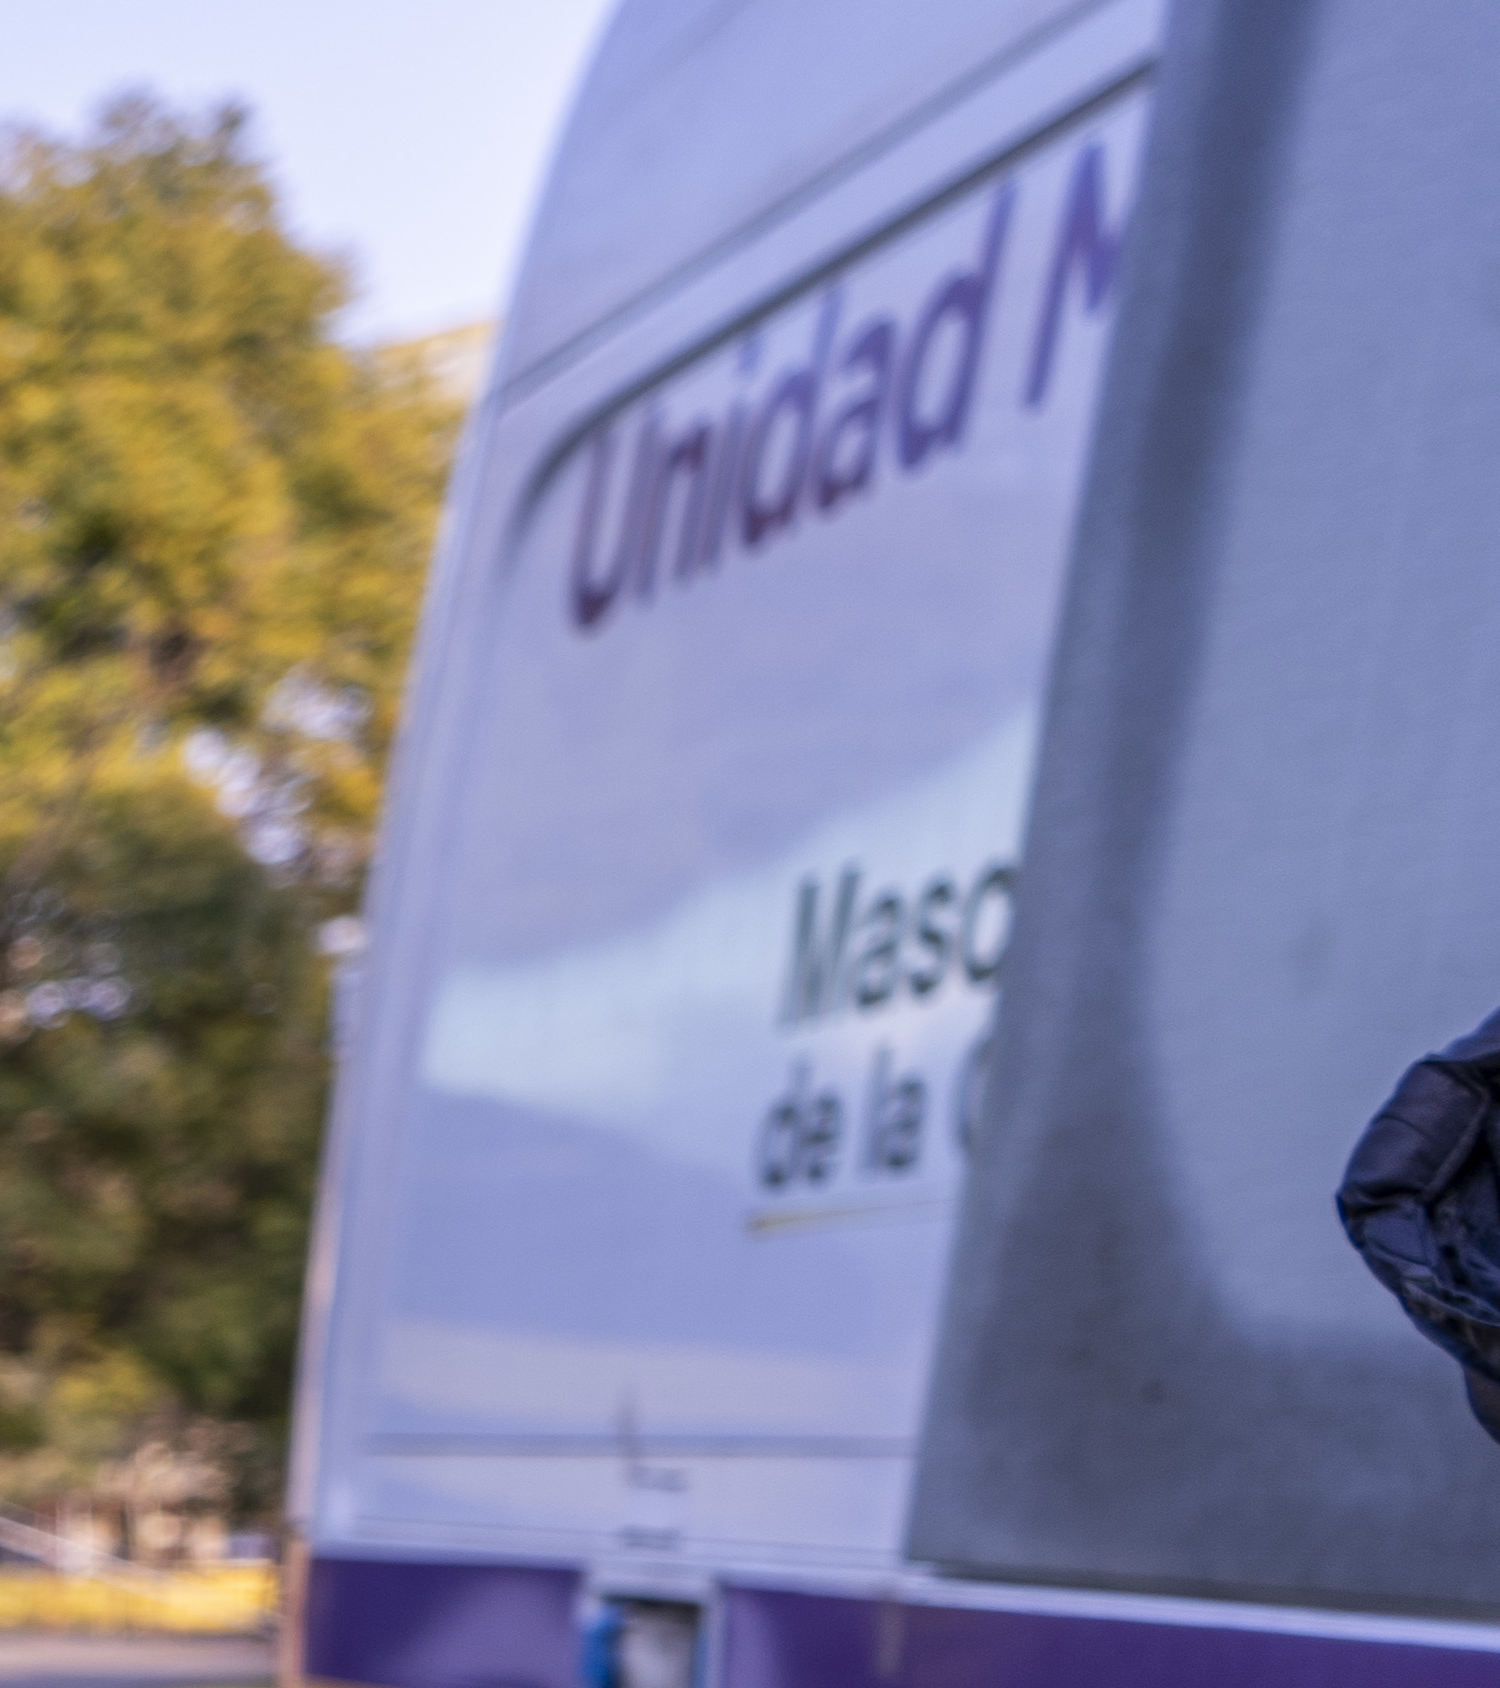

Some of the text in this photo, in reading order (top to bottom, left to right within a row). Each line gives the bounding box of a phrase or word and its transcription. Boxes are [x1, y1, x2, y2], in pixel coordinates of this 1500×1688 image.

[572, 178, 1018, 636] Unidad
[758, 1056, 840, 1194] de
[858, 1046, 924, 1178] la
